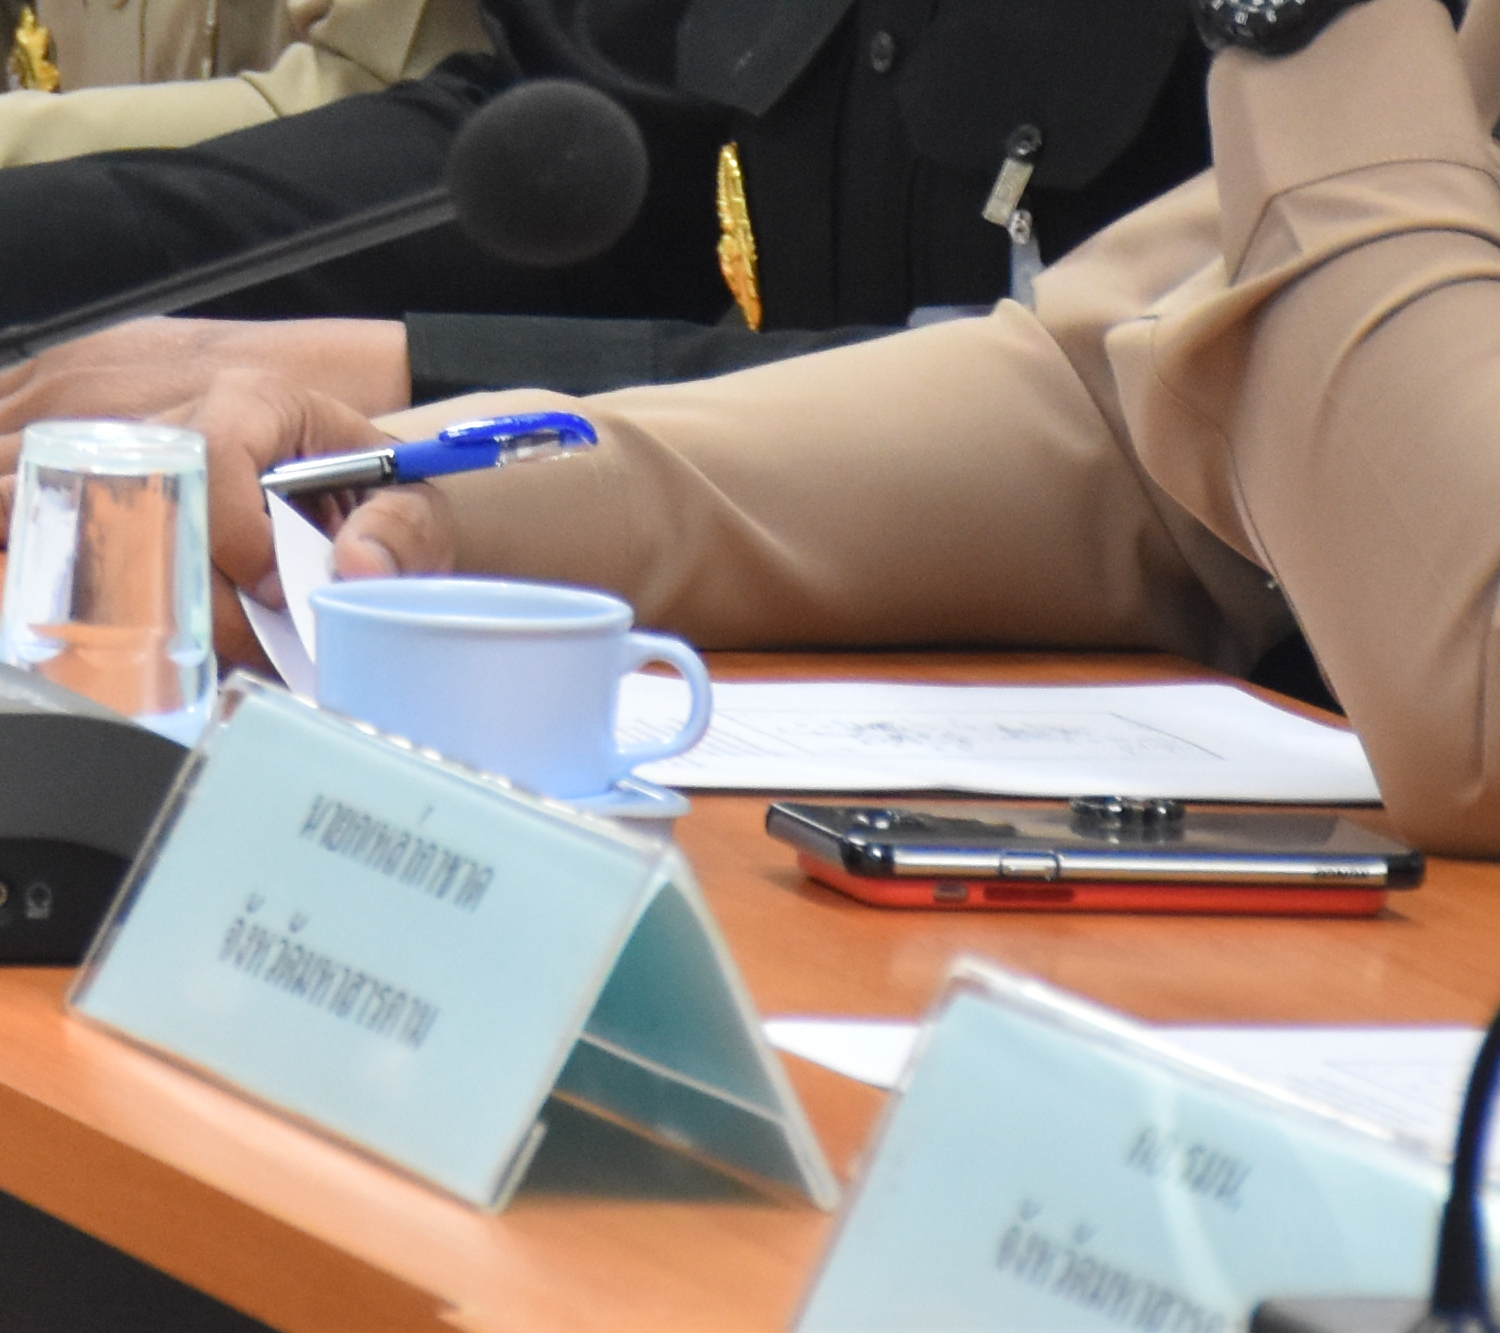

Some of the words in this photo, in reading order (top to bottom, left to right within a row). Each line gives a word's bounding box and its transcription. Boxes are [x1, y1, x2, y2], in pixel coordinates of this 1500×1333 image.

[218, 893, 440, 1051] จังหวัดมหาสารคาม
